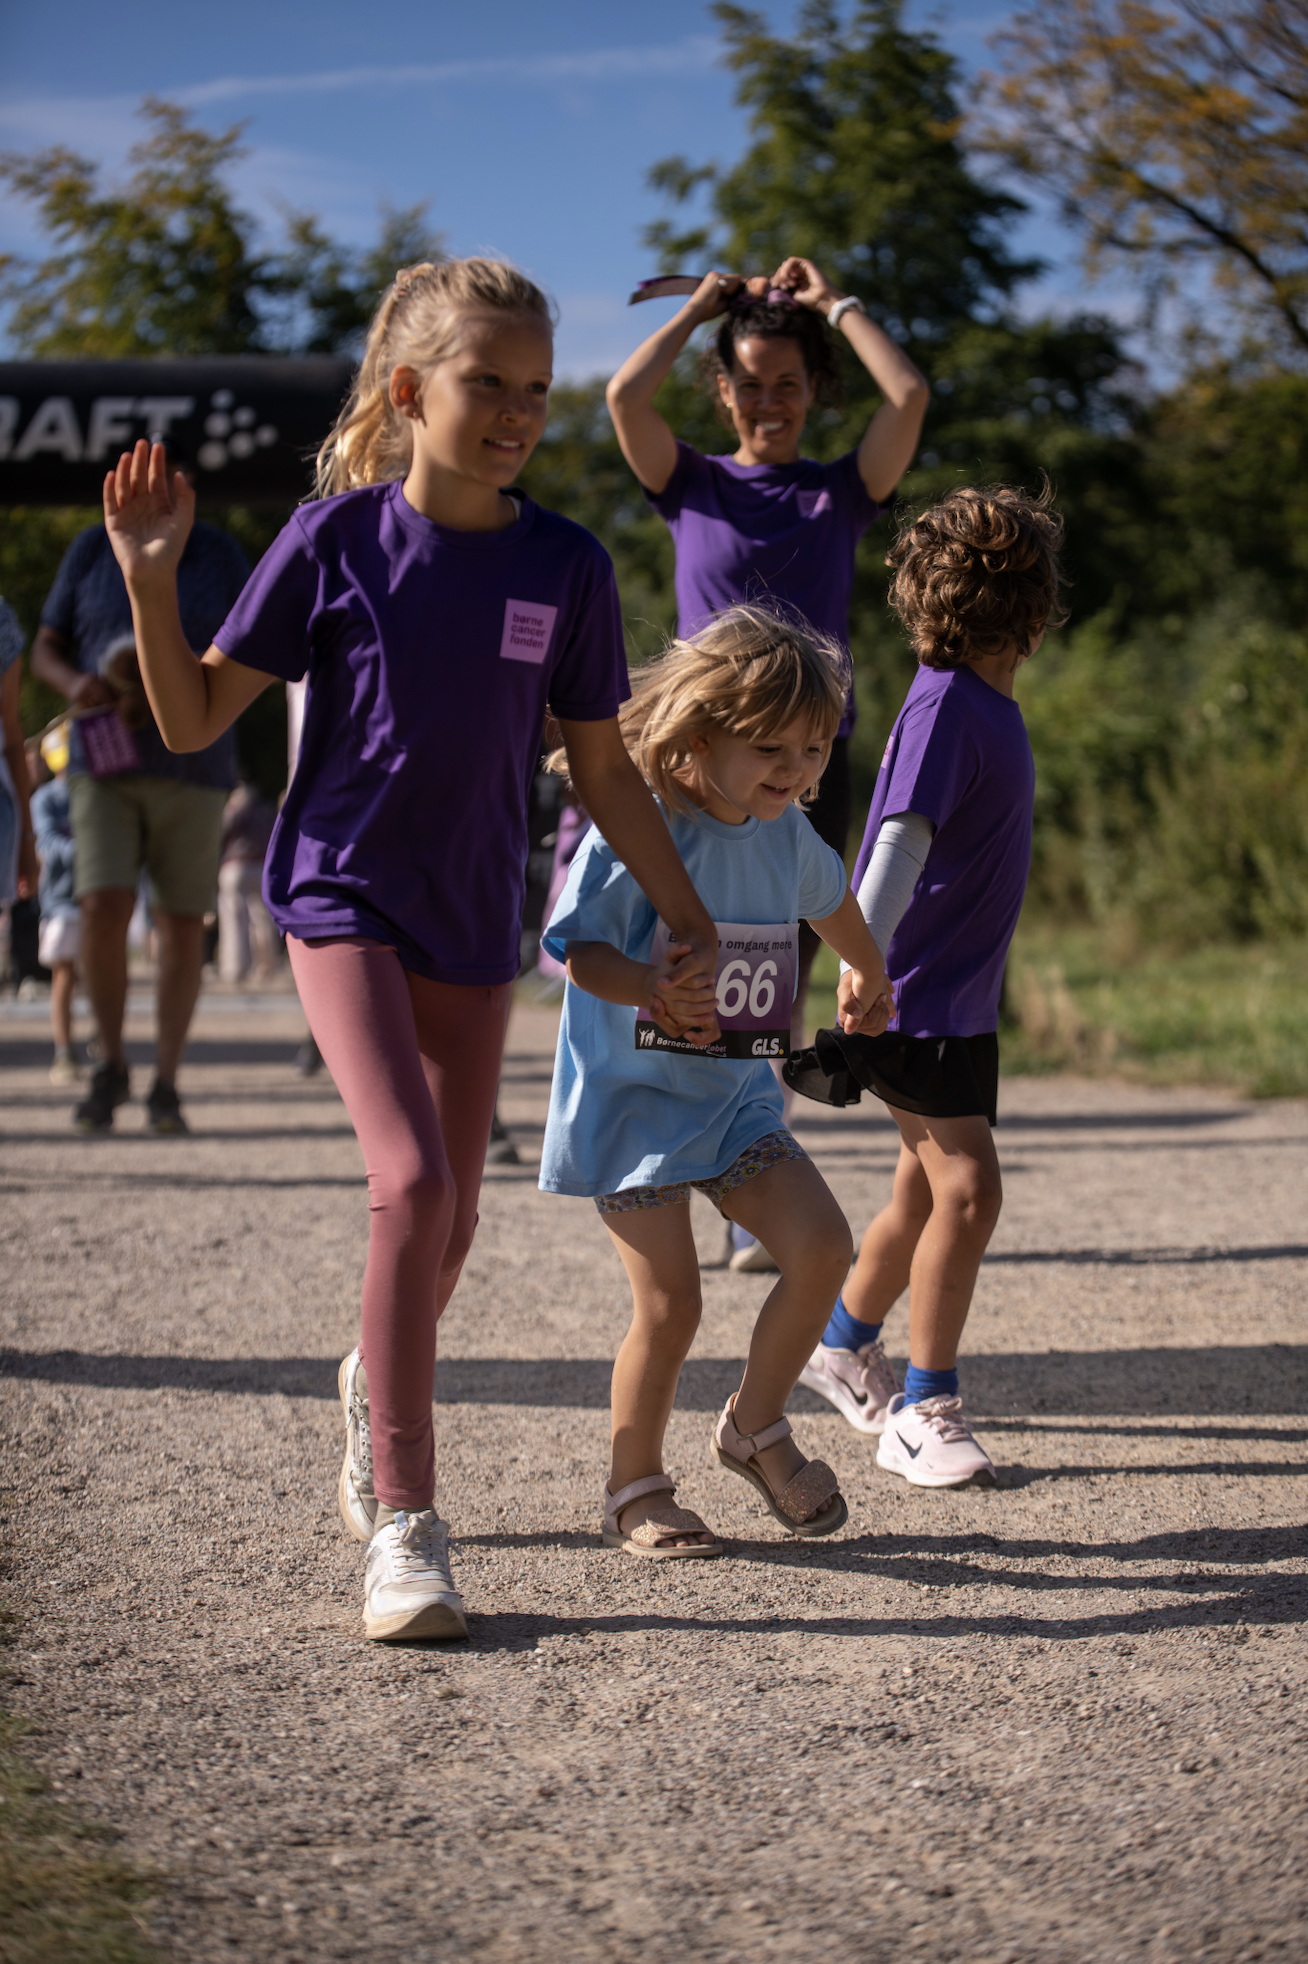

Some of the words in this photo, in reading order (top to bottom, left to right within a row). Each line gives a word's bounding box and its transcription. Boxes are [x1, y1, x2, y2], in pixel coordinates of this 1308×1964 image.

[511, 624, 546, 638] cancer
[510, 633, 544, 649] fonden
[726, 940, 770, 953] omgang
[771, 940, 793, 950] mere
